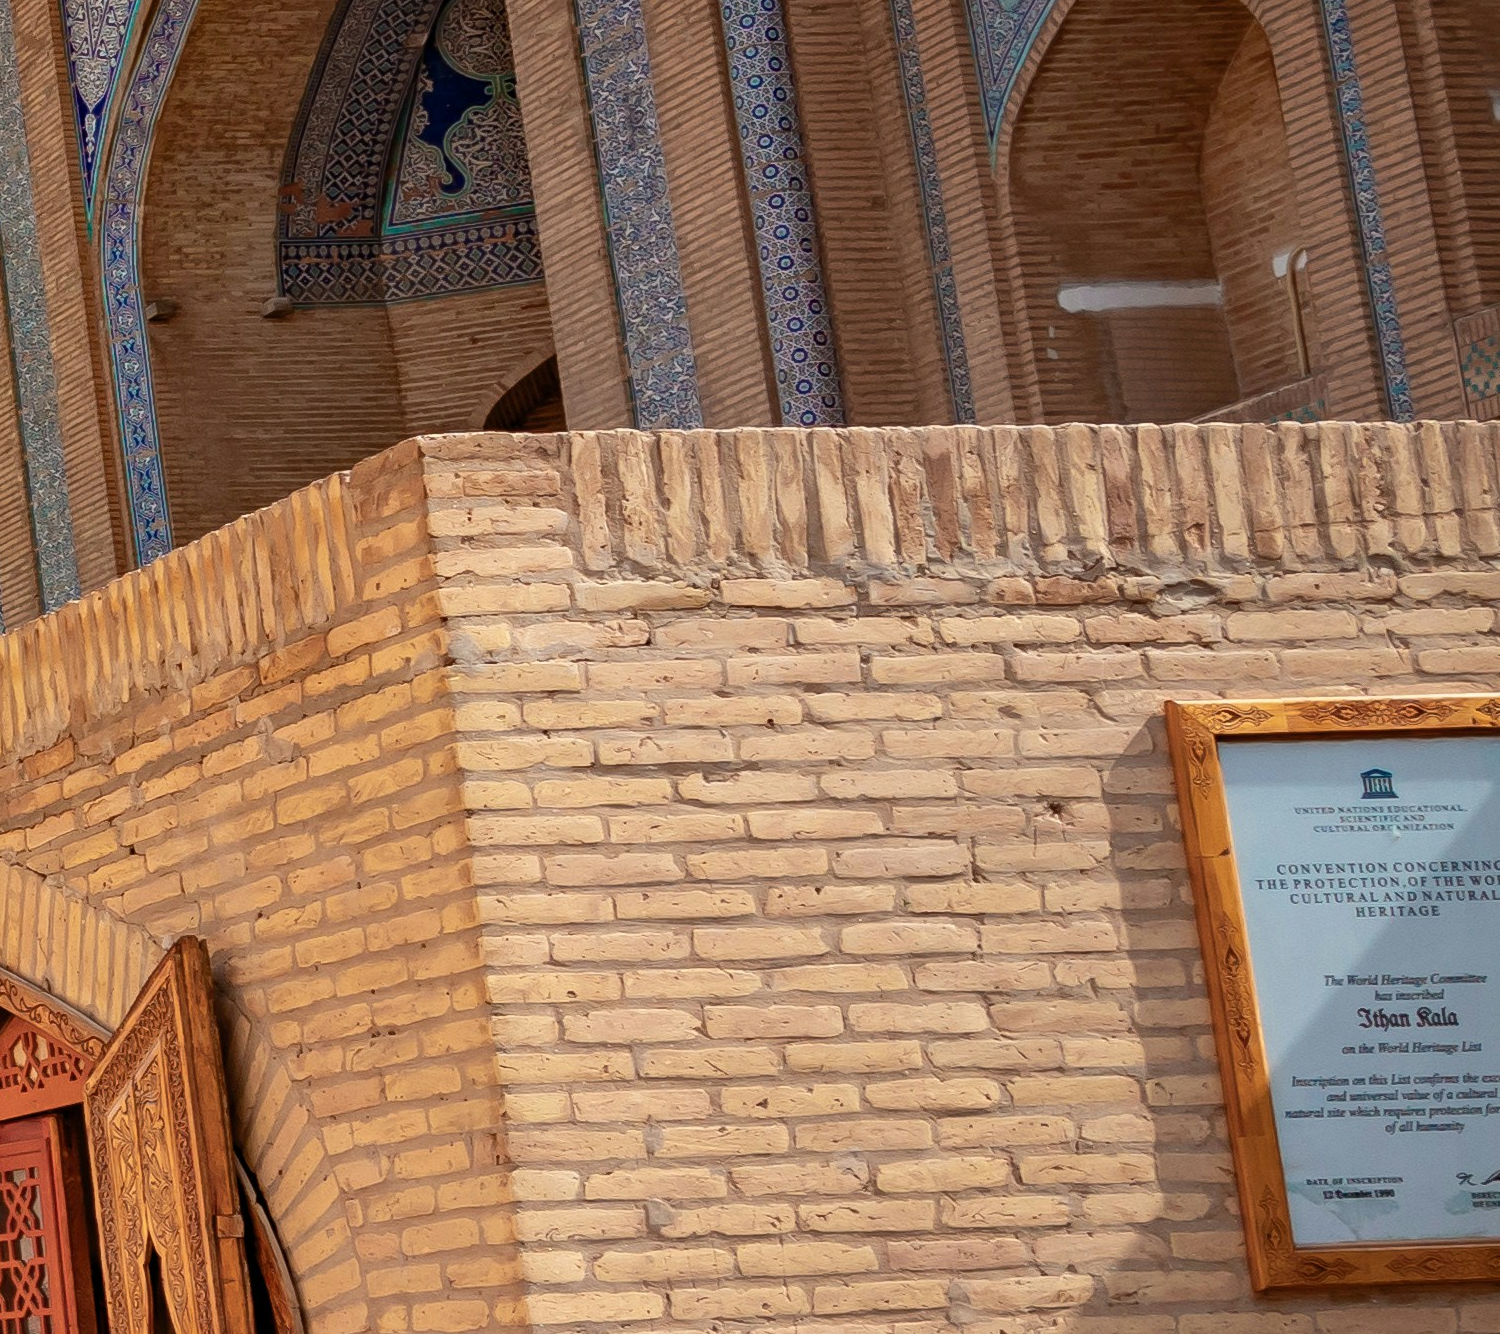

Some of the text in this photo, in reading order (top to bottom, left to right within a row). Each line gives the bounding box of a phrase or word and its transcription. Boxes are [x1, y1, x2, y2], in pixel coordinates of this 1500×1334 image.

[1294, 806, 1335, 815] UNITED
[1337, 805, 1384, 815] NATIONS
[1340, 814, 1425, 824] SCIENTIFIC AND
[1313, 824, 1370, 833] CULTURAL
[1276, 862, 1388, 876] CONVENTION
[1255, 878, 1289, 890] THE
[1408, 876, 1428, 887] OF
[1432, 875, 1466, 887] THE
[1289, 890, 1500, 905] CULTURAL AND NATURAL
[1355, 905, 1441, 918] HERITAGE
[1324, 974, 1344, 987] The
[1347, 974, 1378, 986] World
[1381, 974, 1428, 988] Heritage
[1374, 989, 1445, 1001] has inscribed
[1416, 1006, 1460, 1028] Kala
[1342, 1041, 1482, 1056] on the World Heritage List
[1291, 1075, 1349, 1089] Inscription
[1352, 1077, 1366, 1086] on
[1368, 1074, 1388, 1086] this
[1391, 1073, 1411, 1086] List
[1413, 1072, 1460, 1087] confirms
[1462, 1072, 1479, 1084] the
[1326, 1087, 1498, 1103] and universal value of a cultural
[1285, 1107, 1325, 1119] natural
[1327, 1107, 1346, 1118] site
[1348, 1105, 1381, 1117] which
[1383, 1105, 1426, 1120] requires
[1428, 1104, 1483, 1119] protection
[1384, 1121, 1398, 1135] of
[1399, 1120, 1414, 1133] all
